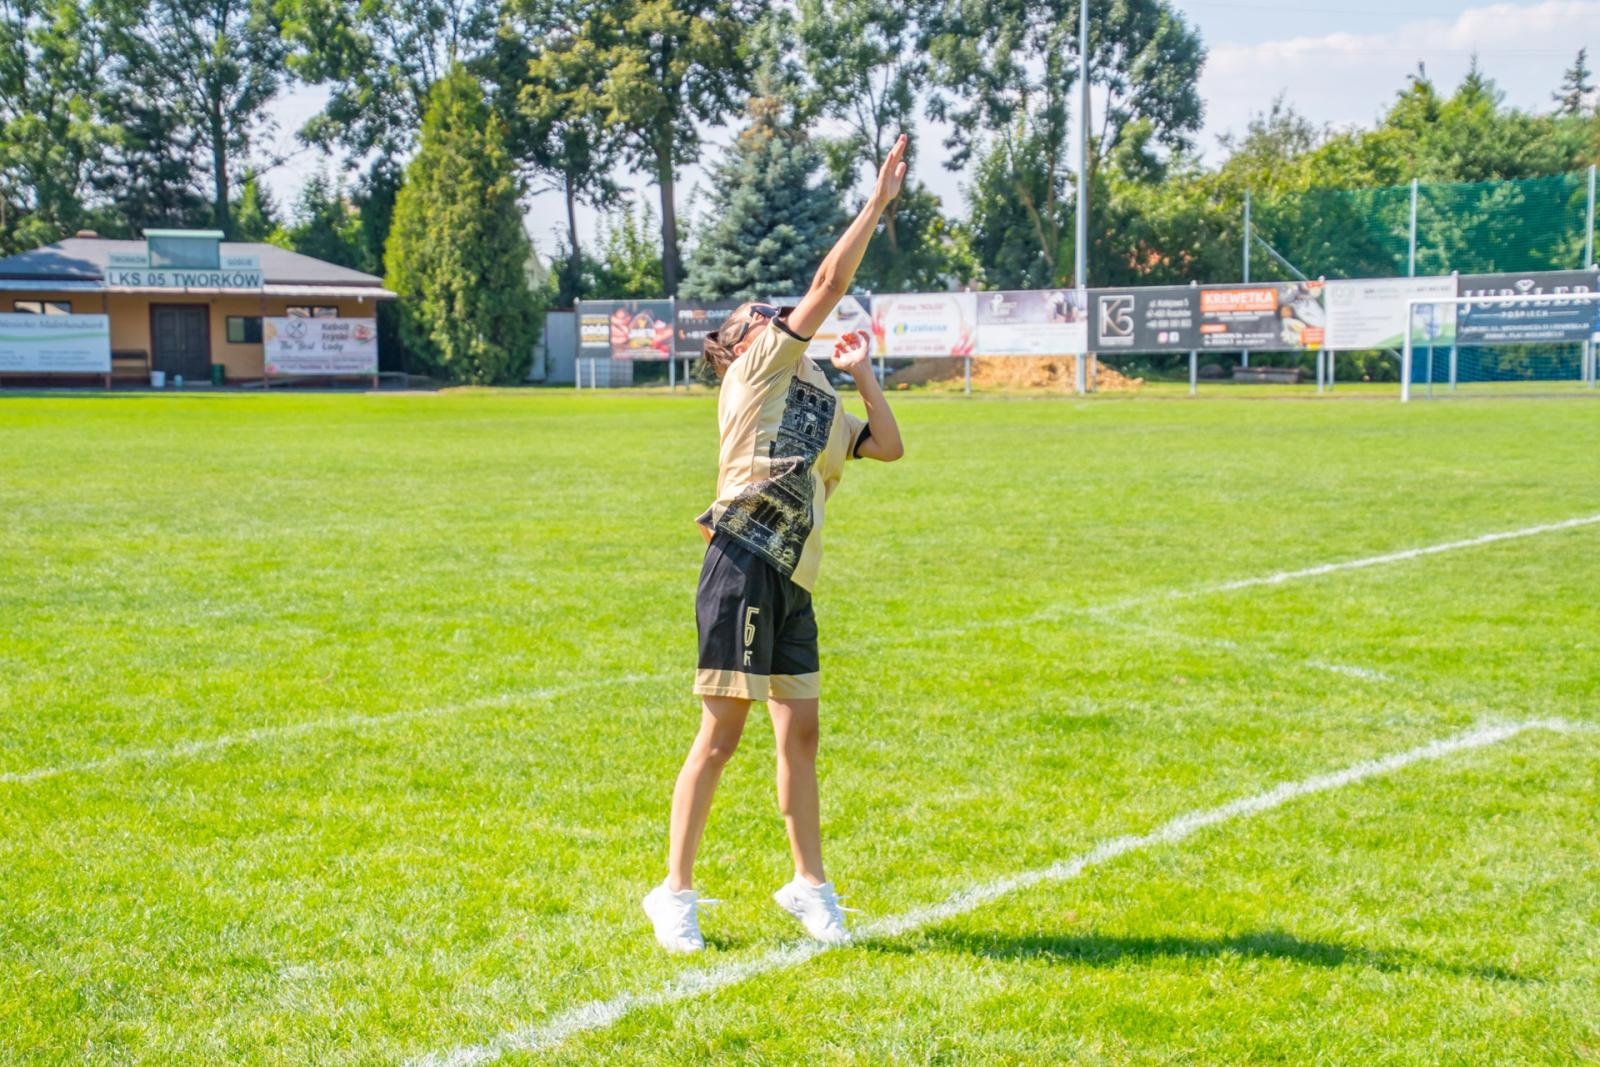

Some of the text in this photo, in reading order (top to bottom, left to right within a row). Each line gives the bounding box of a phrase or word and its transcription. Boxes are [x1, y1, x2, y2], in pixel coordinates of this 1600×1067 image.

[109, 271, 260, 287] LKS 05 TWORKÓW
[1205, 291, 1273, 304] KREWETKA
